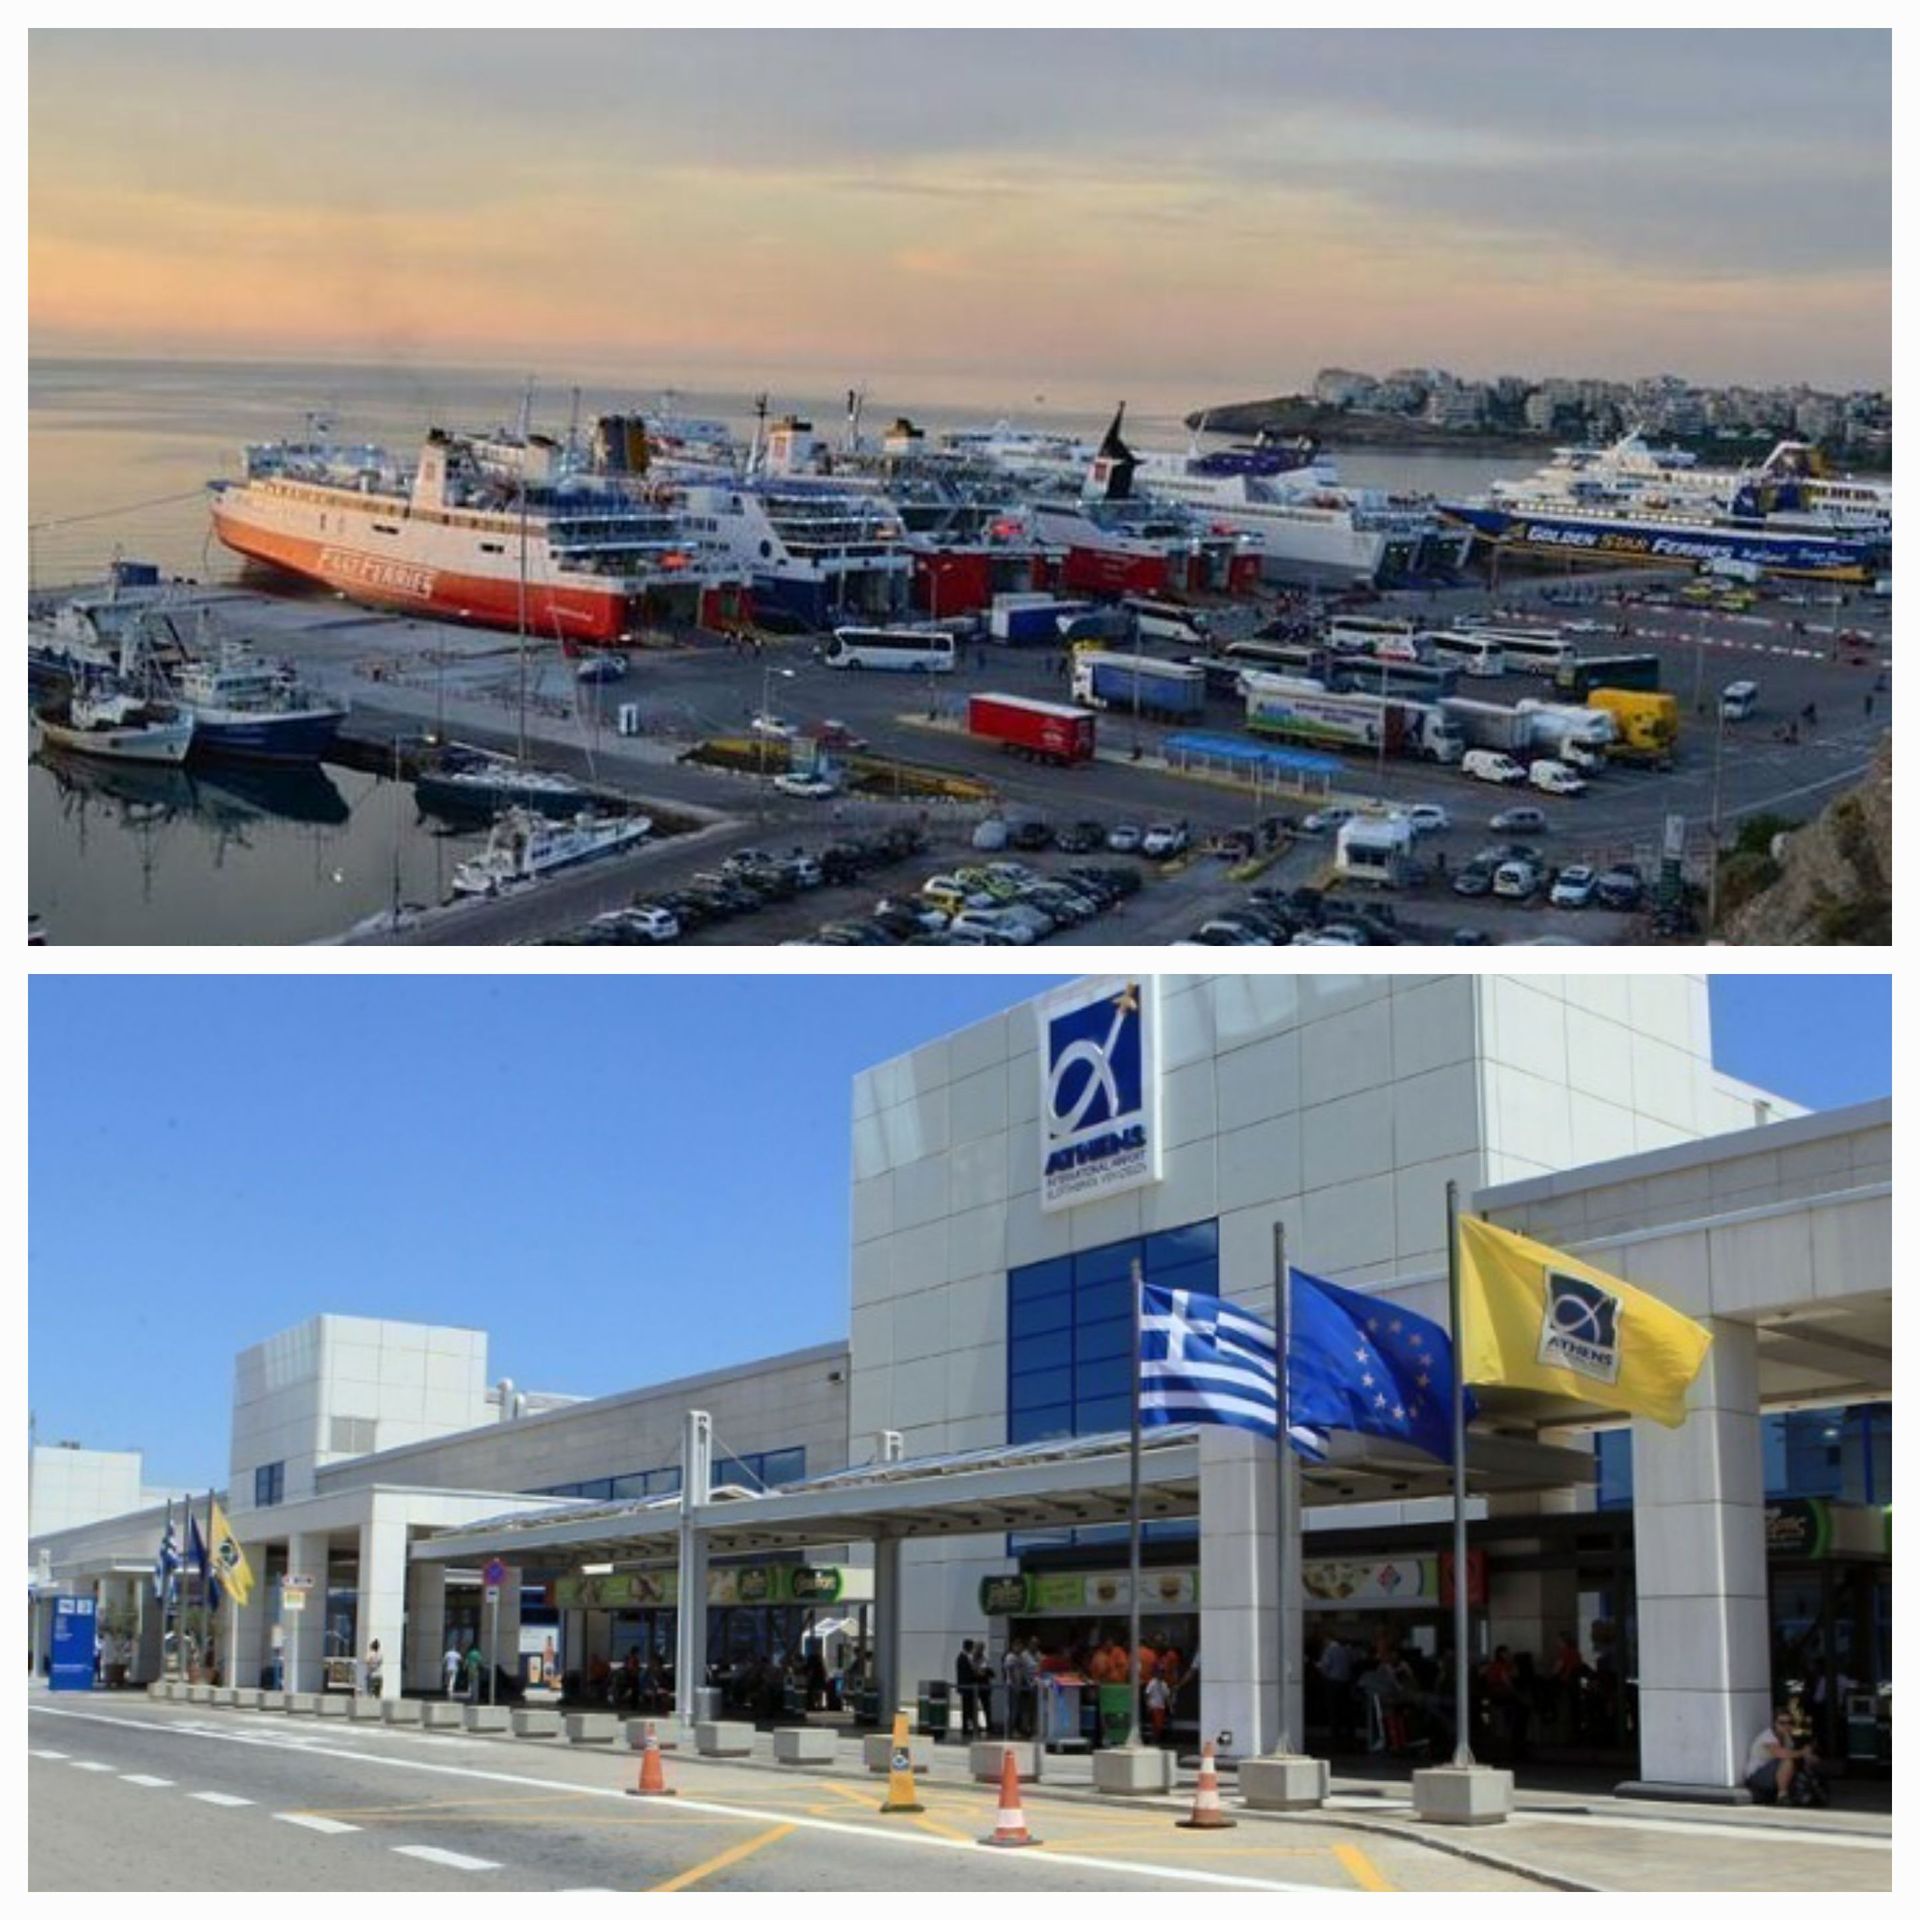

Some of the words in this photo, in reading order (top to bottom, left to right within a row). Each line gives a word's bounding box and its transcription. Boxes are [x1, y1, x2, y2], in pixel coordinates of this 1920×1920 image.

[1527, 525, 1599, 547] GOLDEN
[1044, 1124, 1147, 1177] ATHENS
[1547, 1336, 1613, 1366] ATHENS
